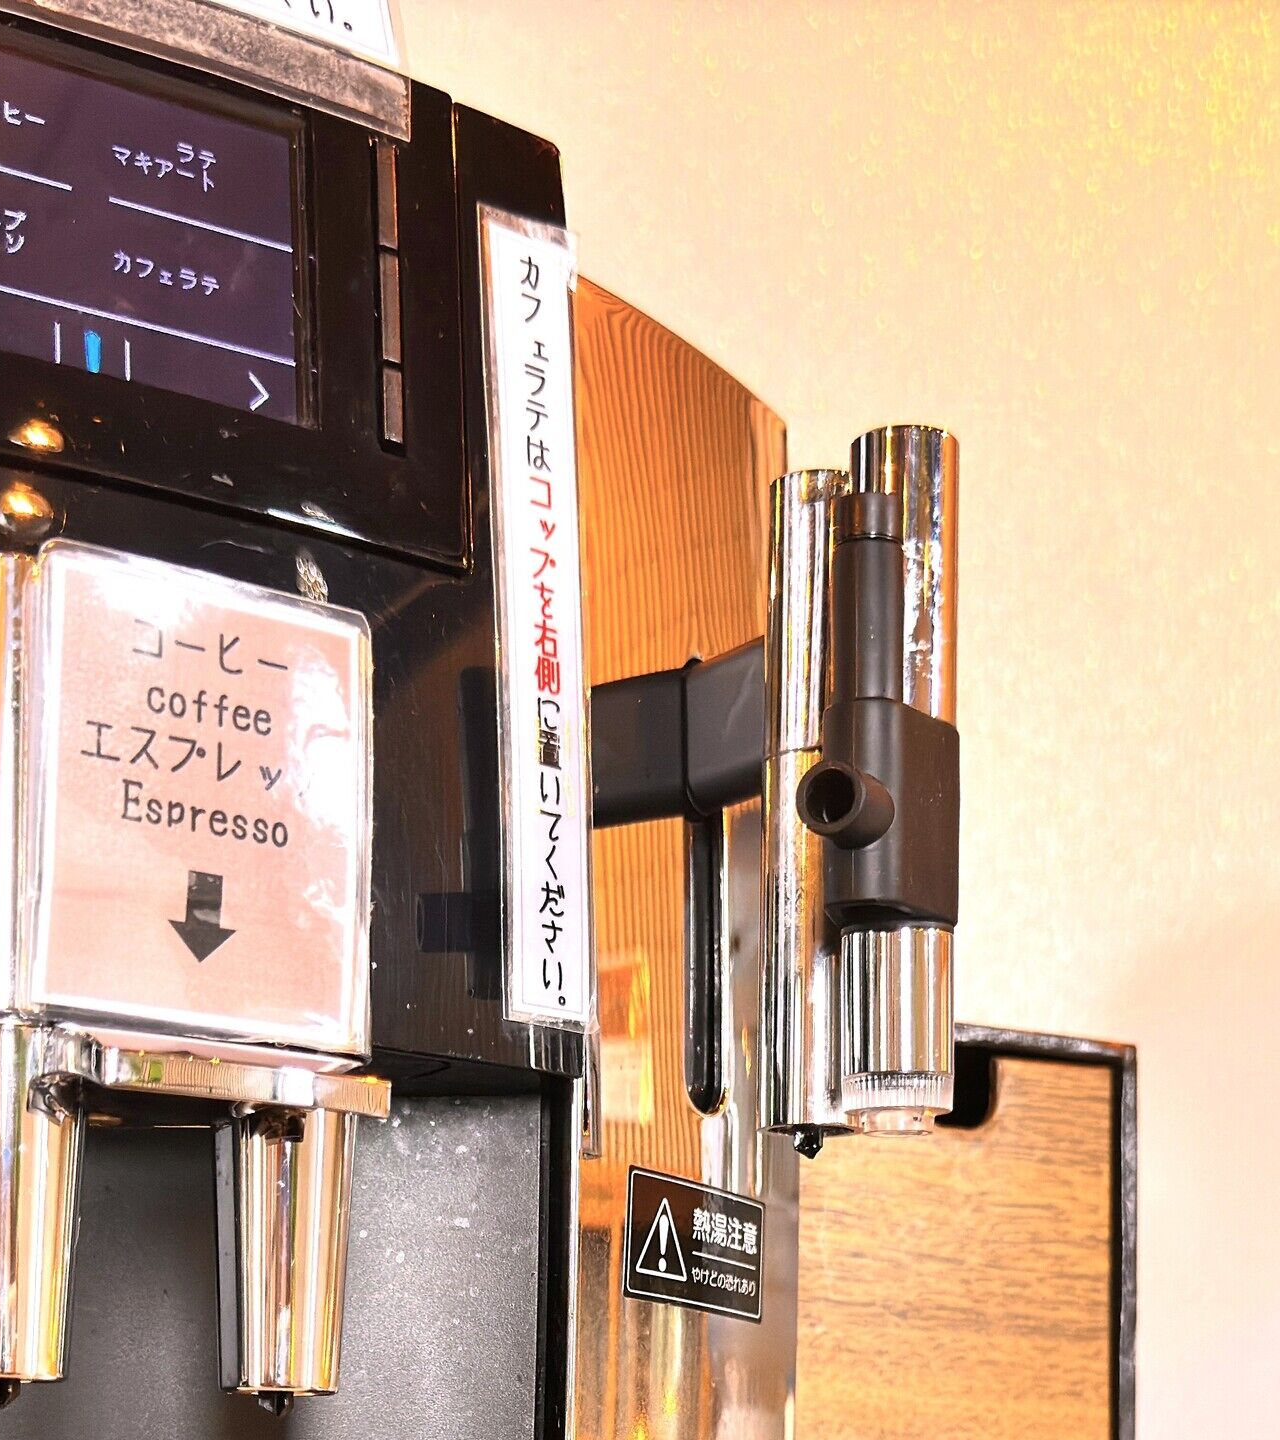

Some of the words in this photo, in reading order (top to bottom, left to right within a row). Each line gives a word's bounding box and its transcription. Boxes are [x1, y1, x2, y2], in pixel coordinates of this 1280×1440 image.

[112, 145, 216, 192] マキアート
[176, 142, 218, 171] ラテ
[113, 249, 220, 295] カフェラテ
[132, 618, 289, 675] コーヒー
[519, 256, 566, 1007] カフェラテはコップを右側に置いてください。
[147, 685, 272, 737] coffee
[81, 720, 312, 797] エスプレッ
[121, 778, 289, 849] Espresso
[692, 1207, 757, 1255] 熱湯注意
